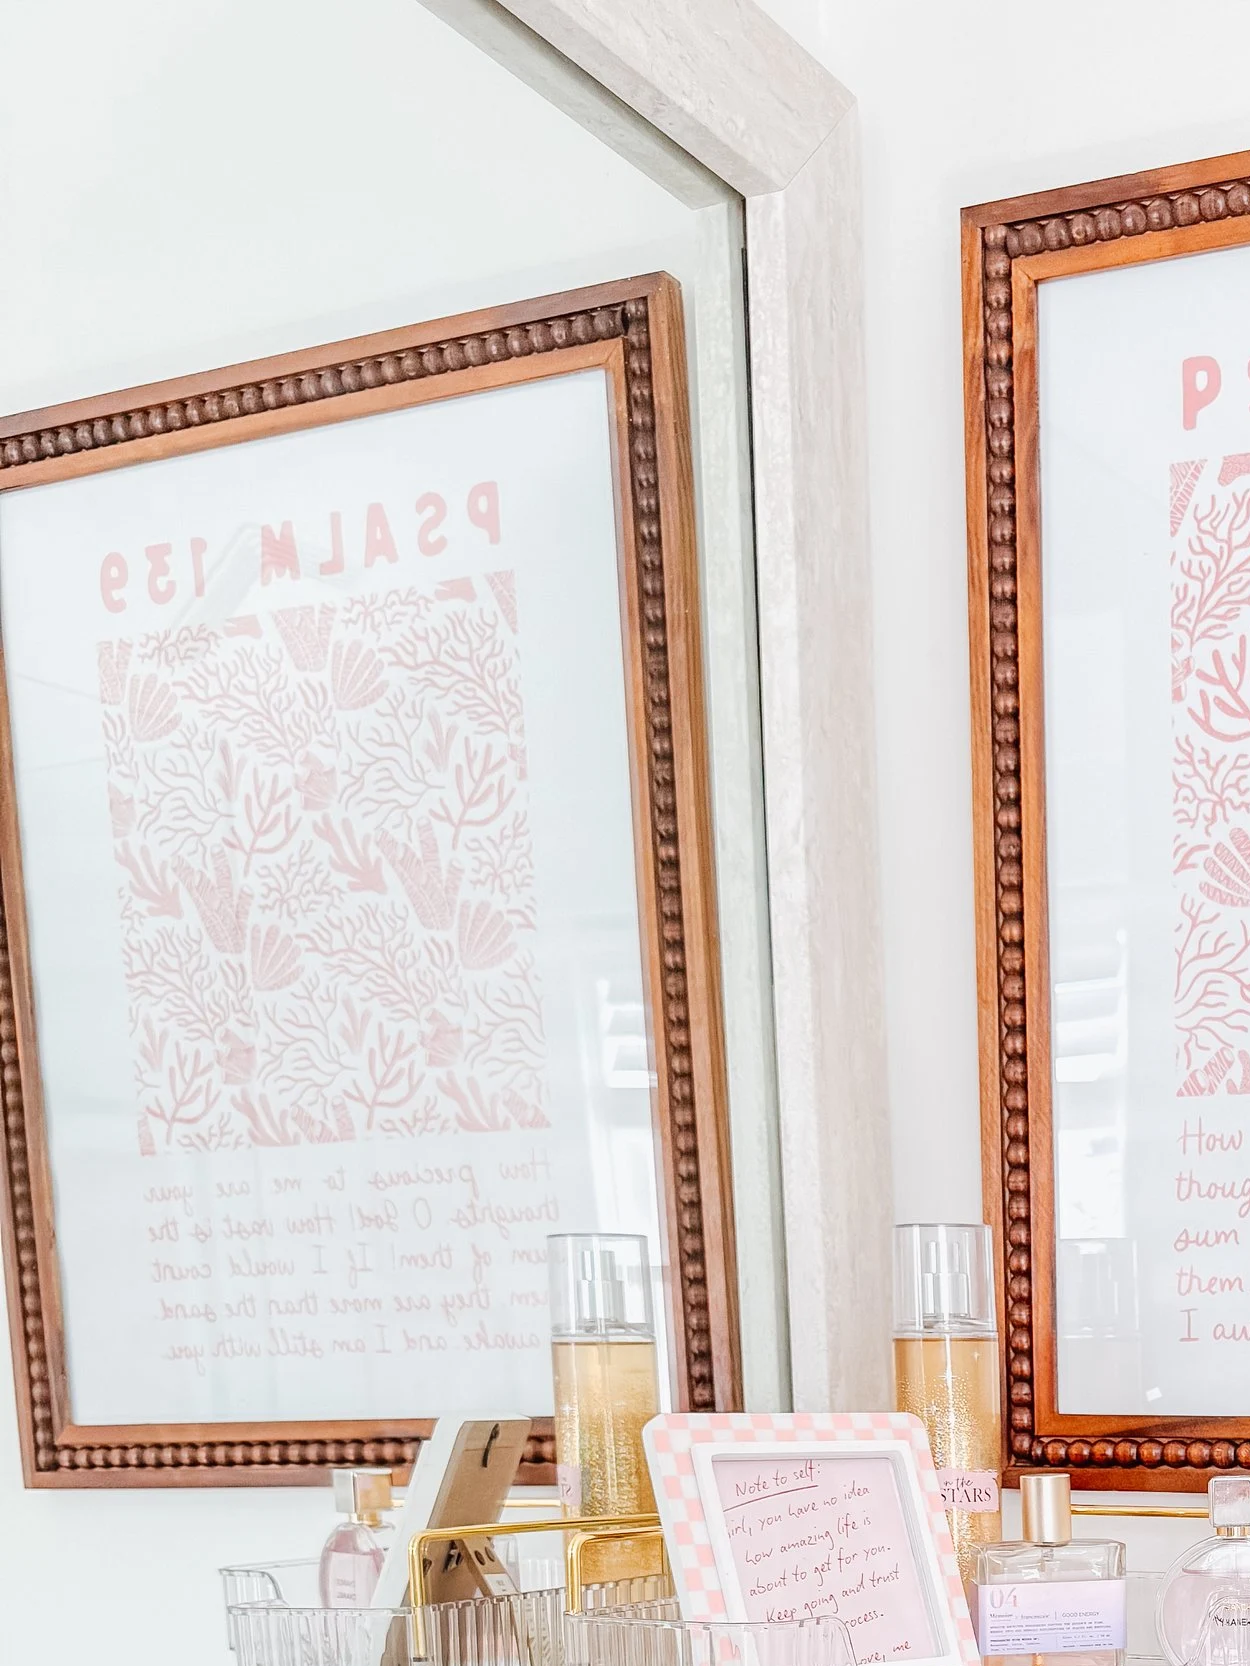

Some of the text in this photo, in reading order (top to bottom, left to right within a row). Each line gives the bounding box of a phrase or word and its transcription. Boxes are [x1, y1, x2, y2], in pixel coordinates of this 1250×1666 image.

[1177, 1115, 1244, 1156] How
[1173, 1226, 1241, 1252] sum
[1178, 1307, 1201, 1342] I
[735, 1459, 821, 1497] Note to self:
[940, 1487, 992, 1503] STARS
[727, 1480, 870, 1539] irl, you have no idea
[745, 1510, 872, 1565] how amazing life is
[749, 1545, 891, 1597] about to get for you.
[766, 1563, 900, 1624] Keep going and trust
[845, 1609, 884, 1628] rocess.
[892, 1641, 912, 1653] me
